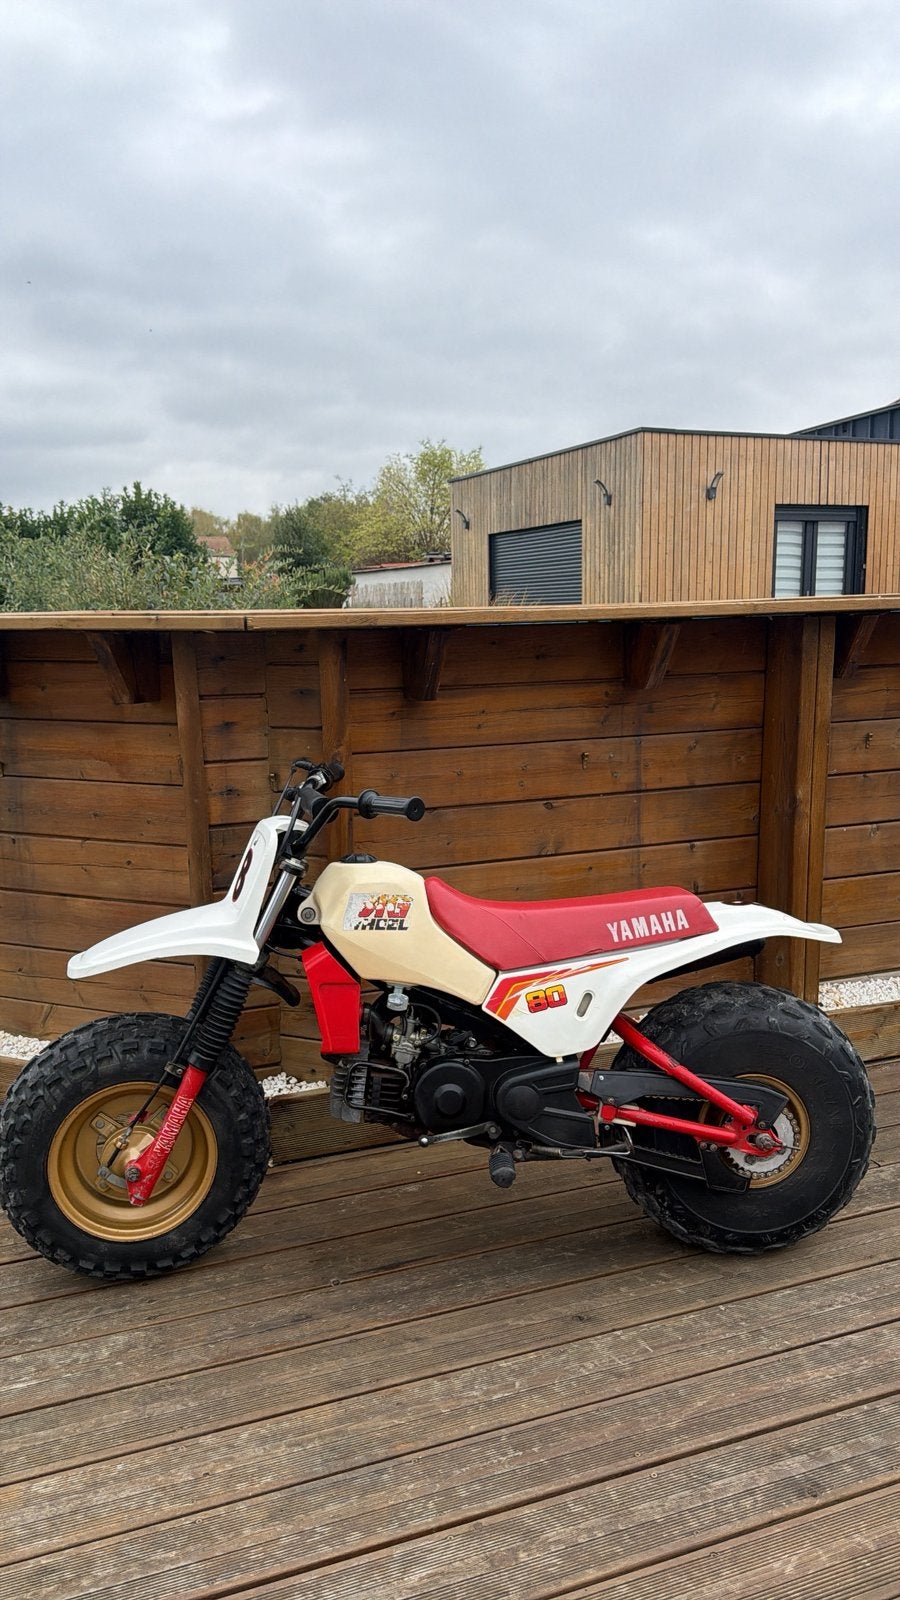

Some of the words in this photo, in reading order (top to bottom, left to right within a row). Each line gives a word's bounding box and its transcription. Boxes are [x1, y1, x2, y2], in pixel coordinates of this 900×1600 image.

[232, 848, 253, 903] 8
[606, 909, 690, 943] YAMAHA
[525, 984, 568, 1014] 80
[152, 1095, 194, 1157] YAMAHA
